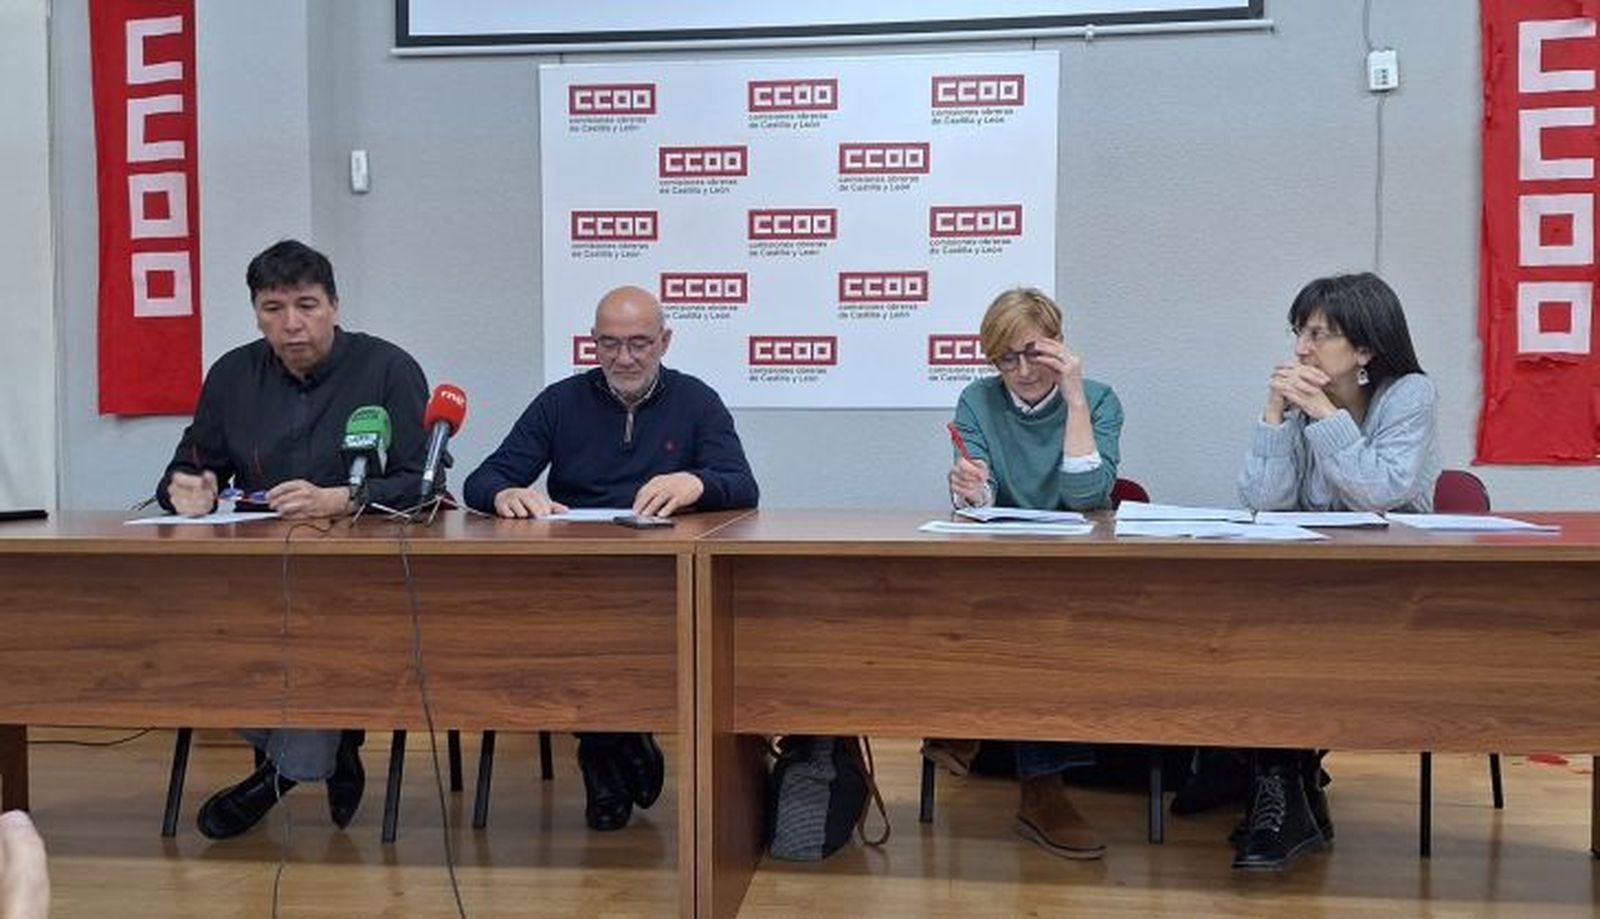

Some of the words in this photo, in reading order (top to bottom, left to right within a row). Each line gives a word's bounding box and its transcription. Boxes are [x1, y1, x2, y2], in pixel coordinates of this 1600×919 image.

[575, 90, 651, 109] CCOO
[754, 85, 832, 106] CCOO
[938, 81, 1018, 102] CCOO
[126, 15, 194, 318] CCOO
[665, 152, 741, 172] CCOO
[845, 149, 923, 168] CCOO
[1518, 18, 1597, 354] CCOO
[577, 217, 652, 236] CCOO
[754, 214, 831, 234] CCOO
[936, 211, 1016, 231] CCOO
[666, 278, 741, 297] CCOO
[845, 277, 922, 296] CCOO
[755, 342, 831, 360] CCOO
[934, 341, 986, 359] CC
